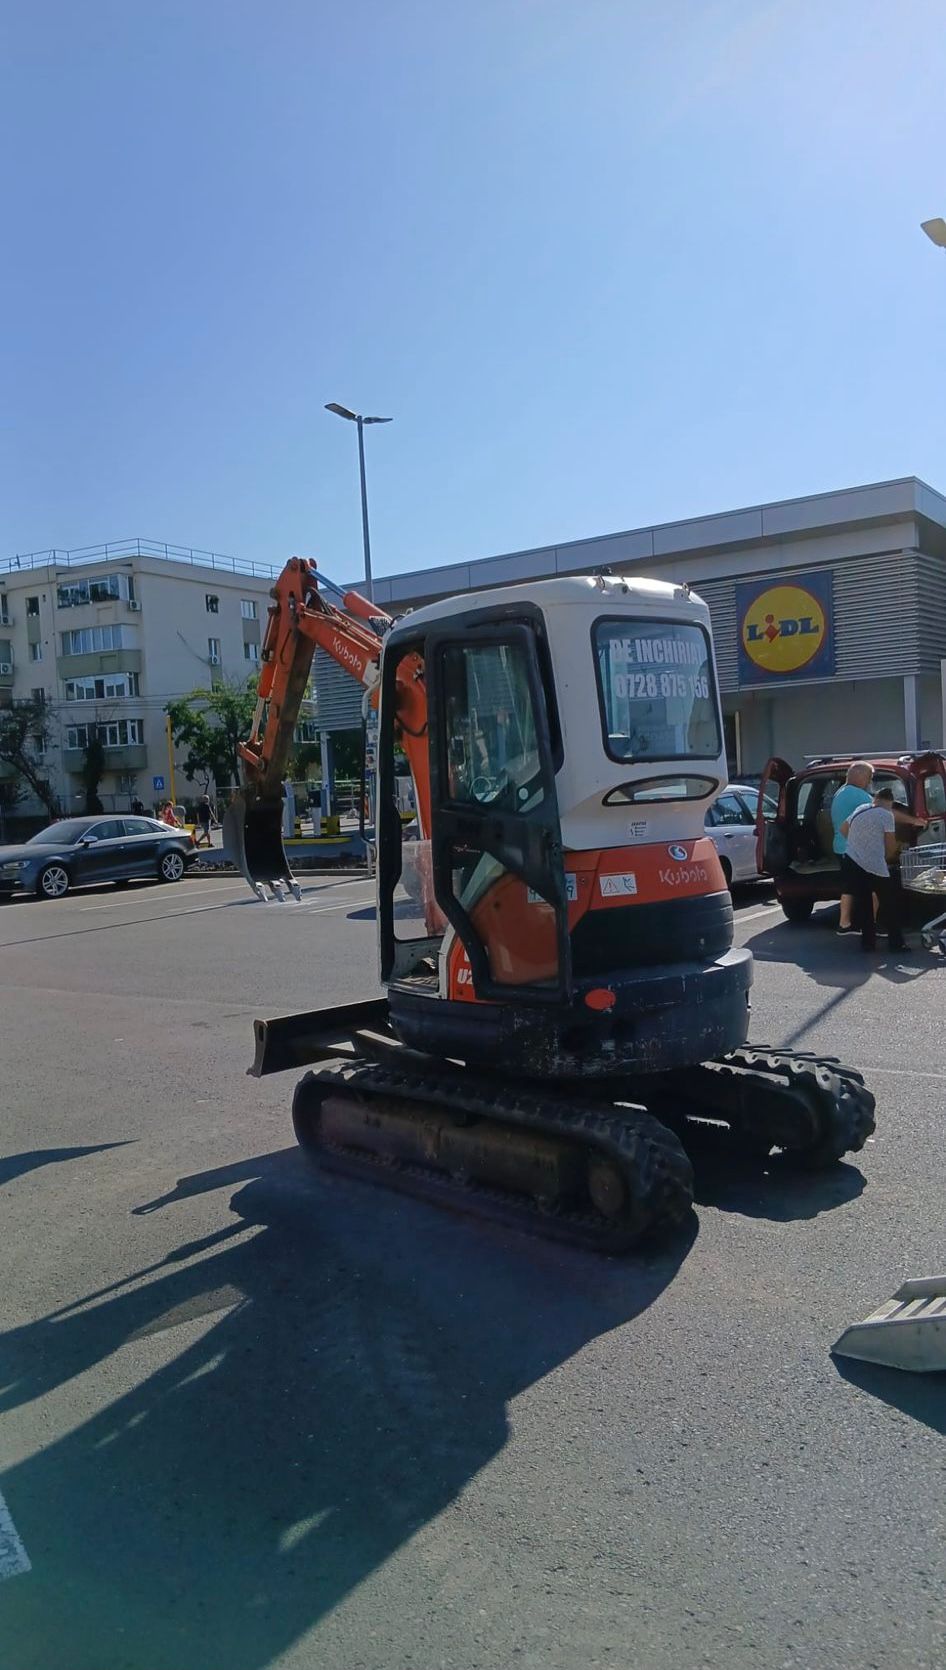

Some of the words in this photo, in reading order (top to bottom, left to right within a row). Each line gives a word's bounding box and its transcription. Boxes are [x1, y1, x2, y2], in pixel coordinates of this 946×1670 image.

[332, 636, 362, 671] Kubota
[609, 639, 633, 662] DE
[615, 673, 658, 698] 0728
[661, 674, 687, 698] 875
[658, 865, 707, 885] Kubota
